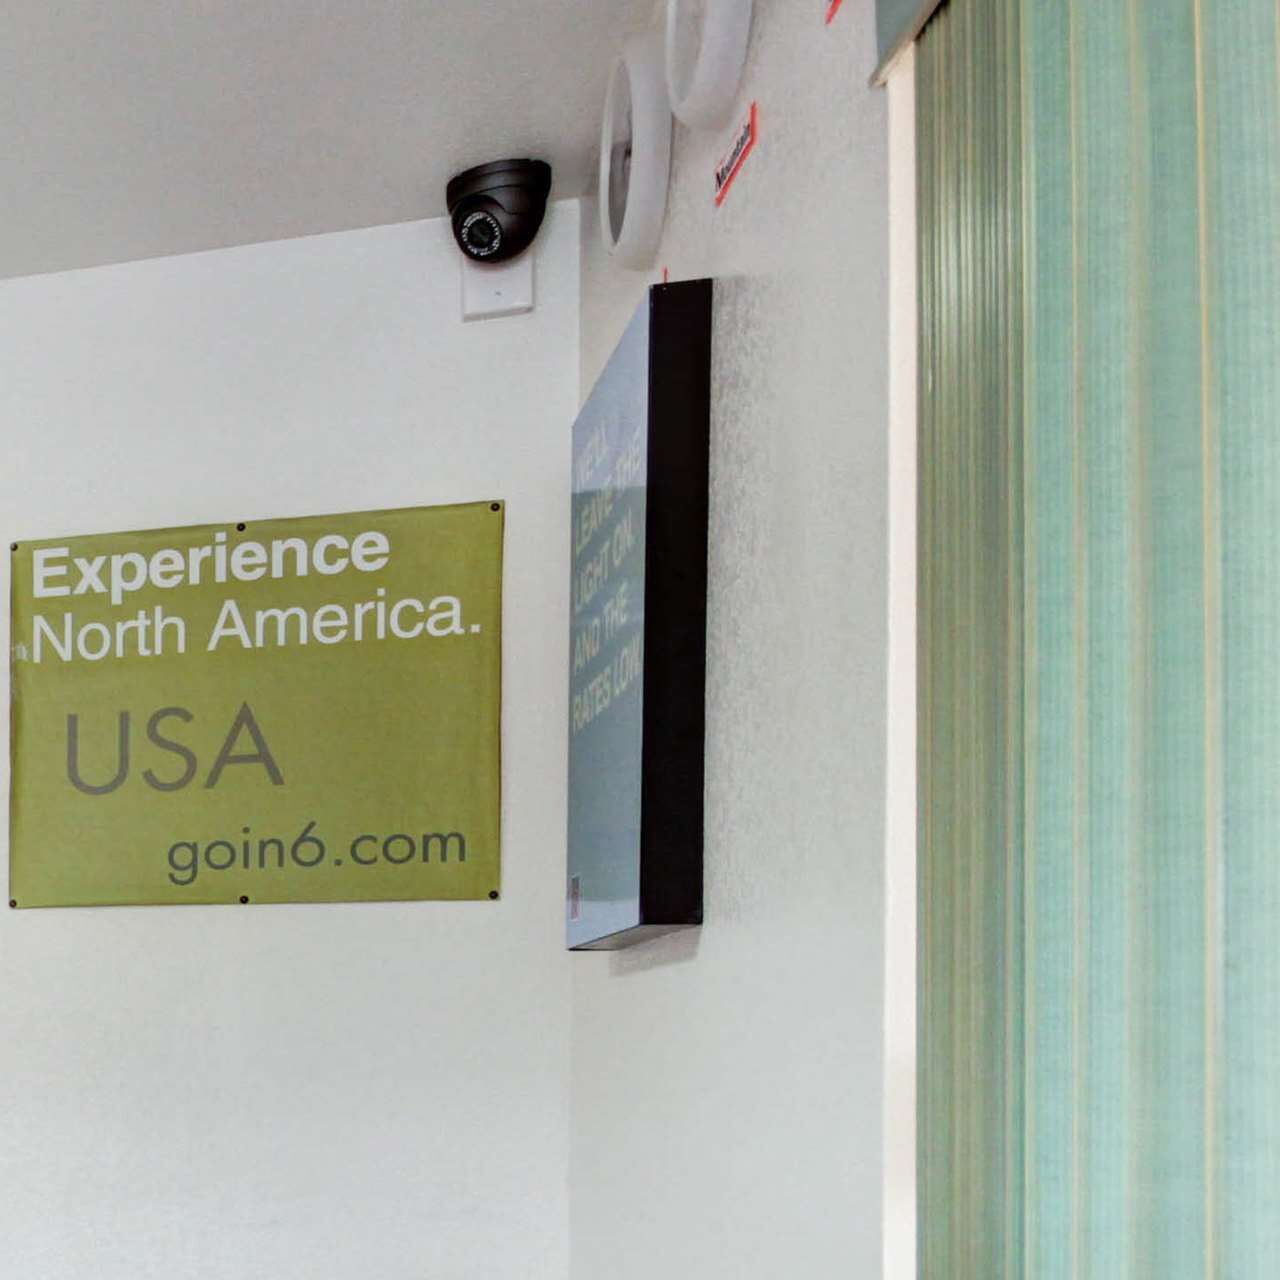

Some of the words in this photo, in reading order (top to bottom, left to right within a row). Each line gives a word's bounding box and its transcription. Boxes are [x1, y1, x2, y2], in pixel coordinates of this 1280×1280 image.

[33, 531, 390, 605] Experience
[33, 605, 186, 663] North
[207, 588, 481, 651] America.
[66, 702, 284, 796] USA
[168, 820, 467, 886] goin6.com
